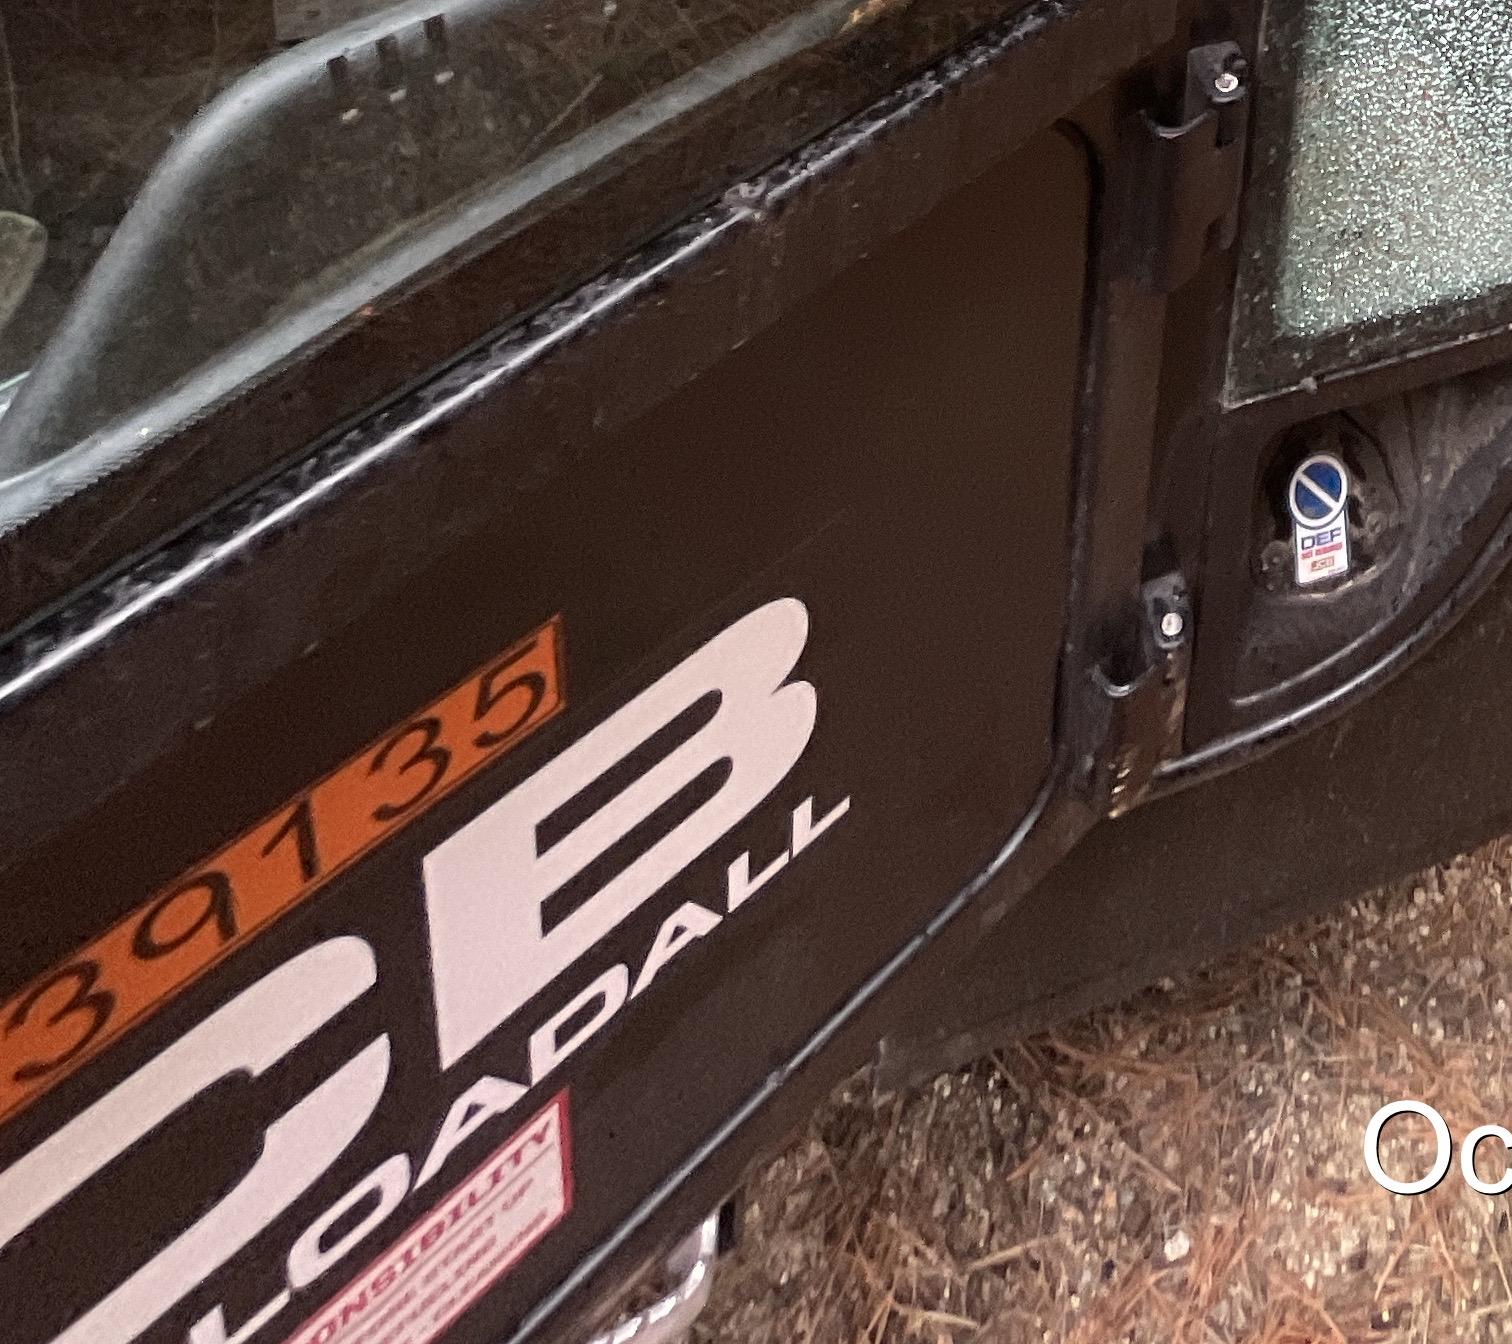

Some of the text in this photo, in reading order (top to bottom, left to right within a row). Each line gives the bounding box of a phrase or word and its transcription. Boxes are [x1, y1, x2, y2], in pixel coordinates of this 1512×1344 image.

[1301, 527, 1341, 550] DEF
[4, 638, 546, 1082] 39135
[189, 794, 851, 1344] LOADALL
